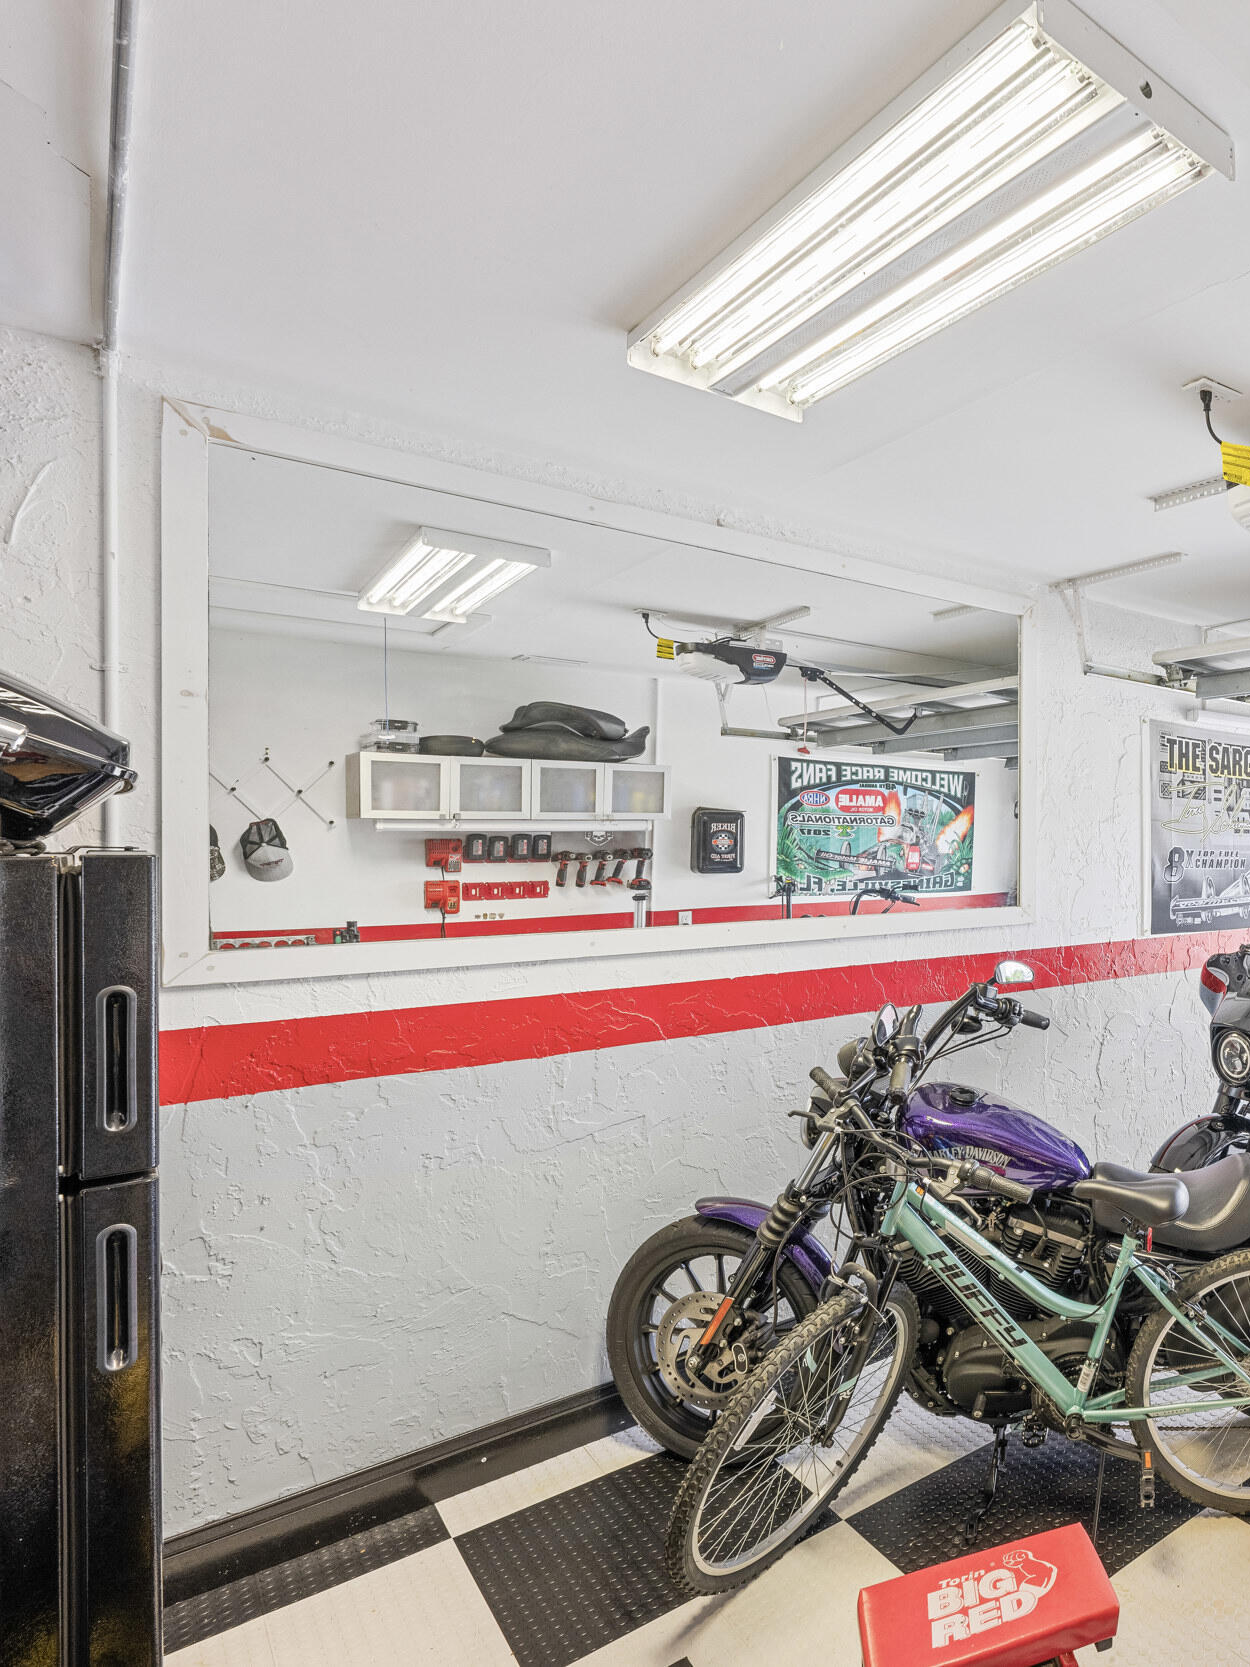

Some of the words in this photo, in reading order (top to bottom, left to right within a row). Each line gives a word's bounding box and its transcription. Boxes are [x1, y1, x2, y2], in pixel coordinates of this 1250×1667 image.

[1166, 736, 1201, 774] THE
[1195, 858, 1246, 869] CHAMPION
[926, 1250, 1028, 1348] HUFFY
[927, 1568, 1018, 1620] BIG
[938, 1569, 985, 1588] Torin
[931, 1590, 1038, 1649] RED
